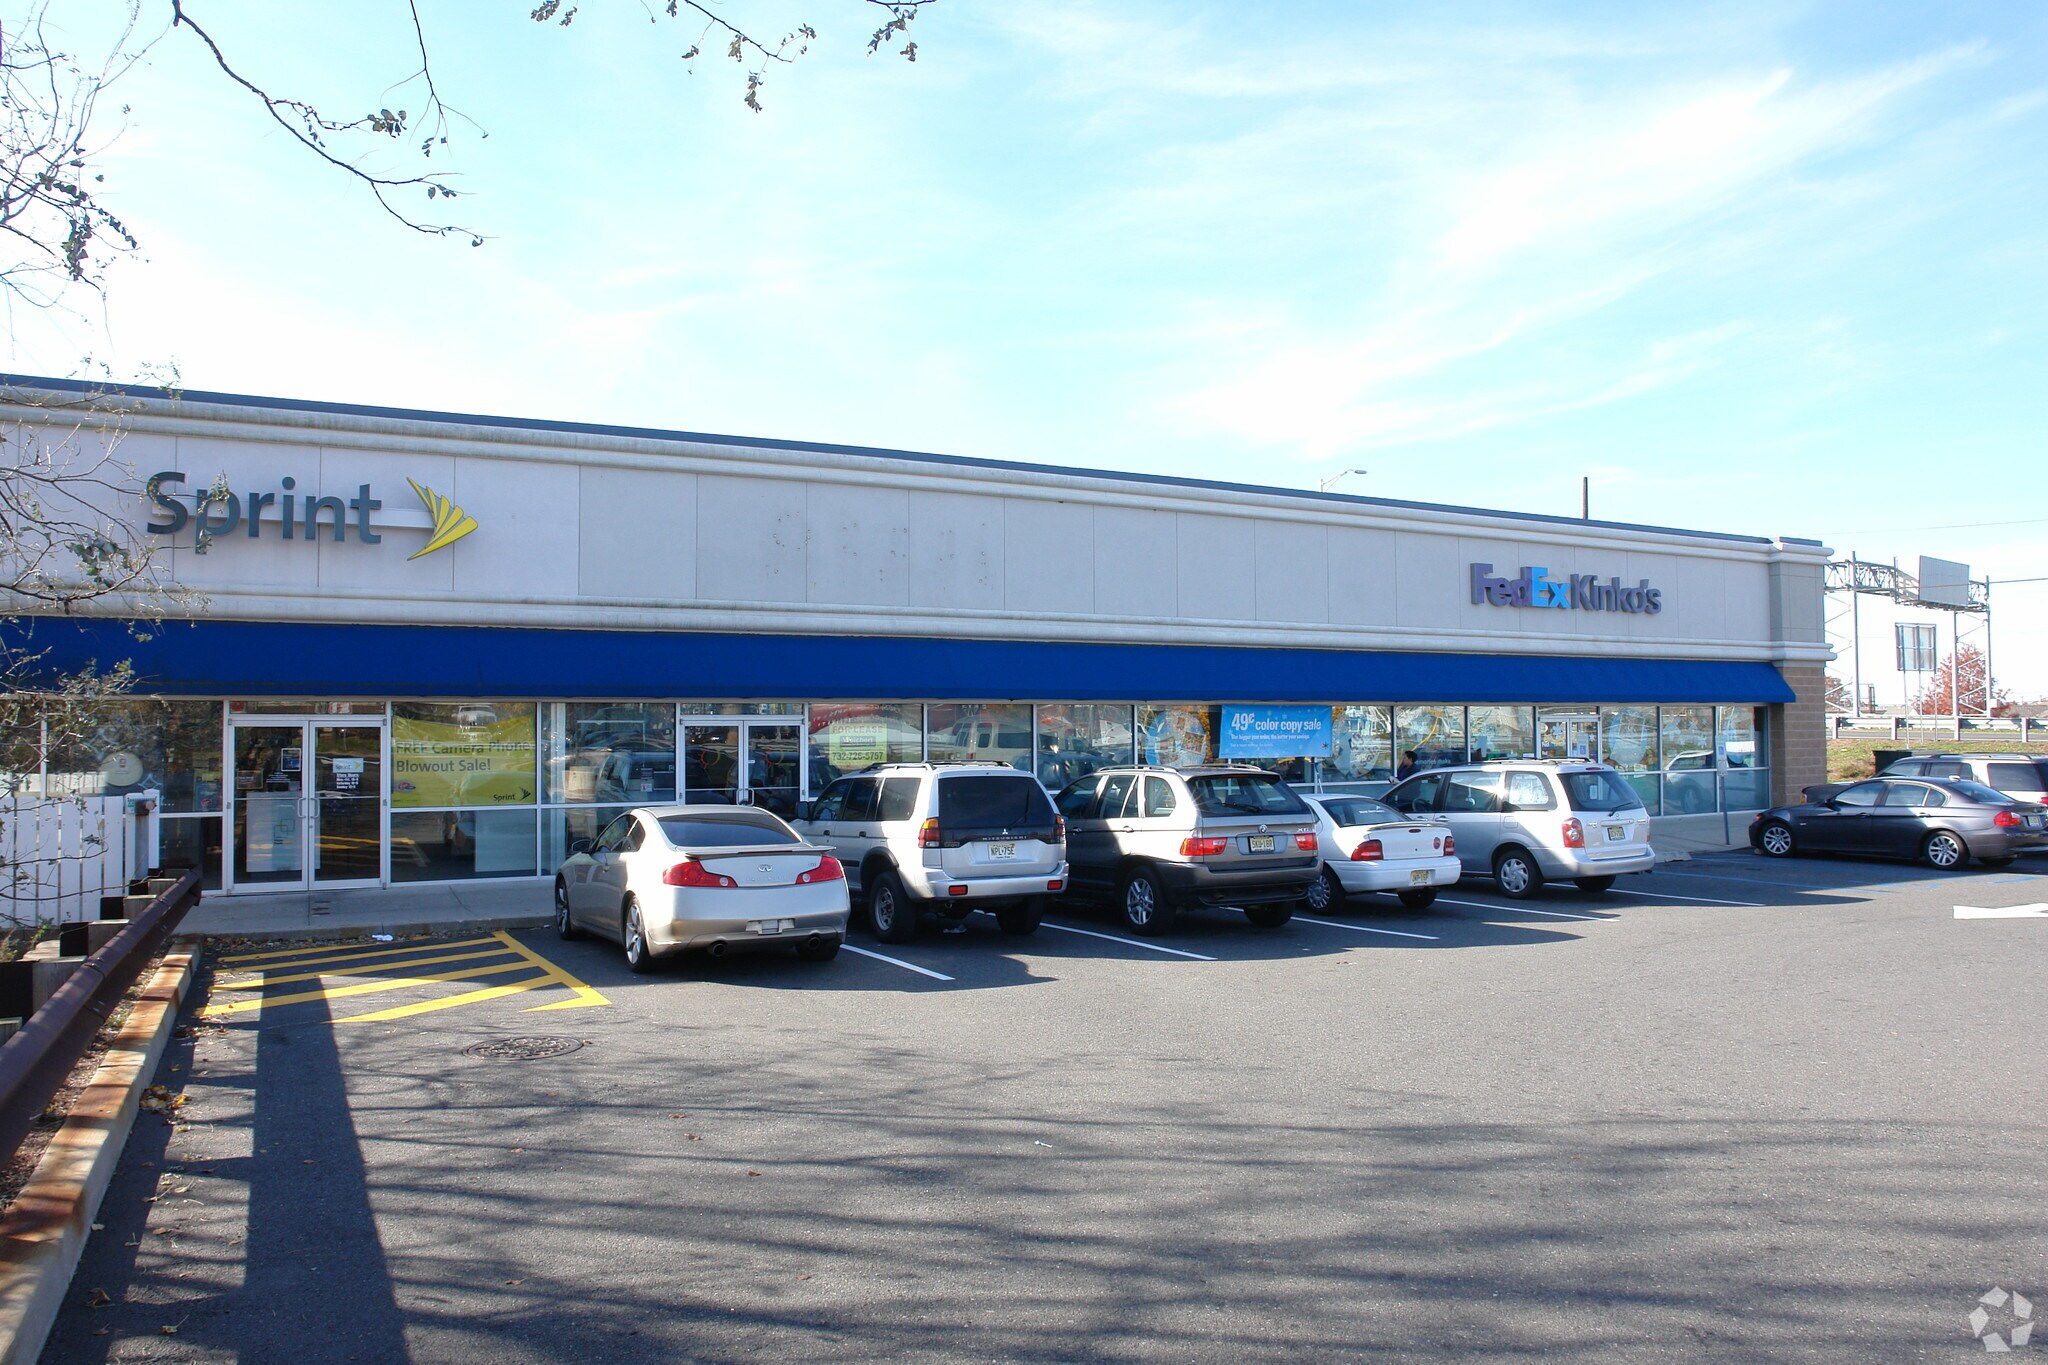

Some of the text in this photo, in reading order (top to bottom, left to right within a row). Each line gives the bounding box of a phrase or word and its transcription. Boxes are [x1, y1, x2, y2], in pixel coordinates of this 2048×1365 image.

[146, 471, 382, 555] Sprint
[1470, 562, 1662, 615] FedEx Kinko's
[832, 725, 883, 734] FOR LEASE
[1231, 712, 1321, 733] 49¢ color copy sale
[396, 740, 531, 754] FREE Camera Phone
[396, 758, 491, 772] Blowout Sale!
[493, 793, 516, 803] Sprint
